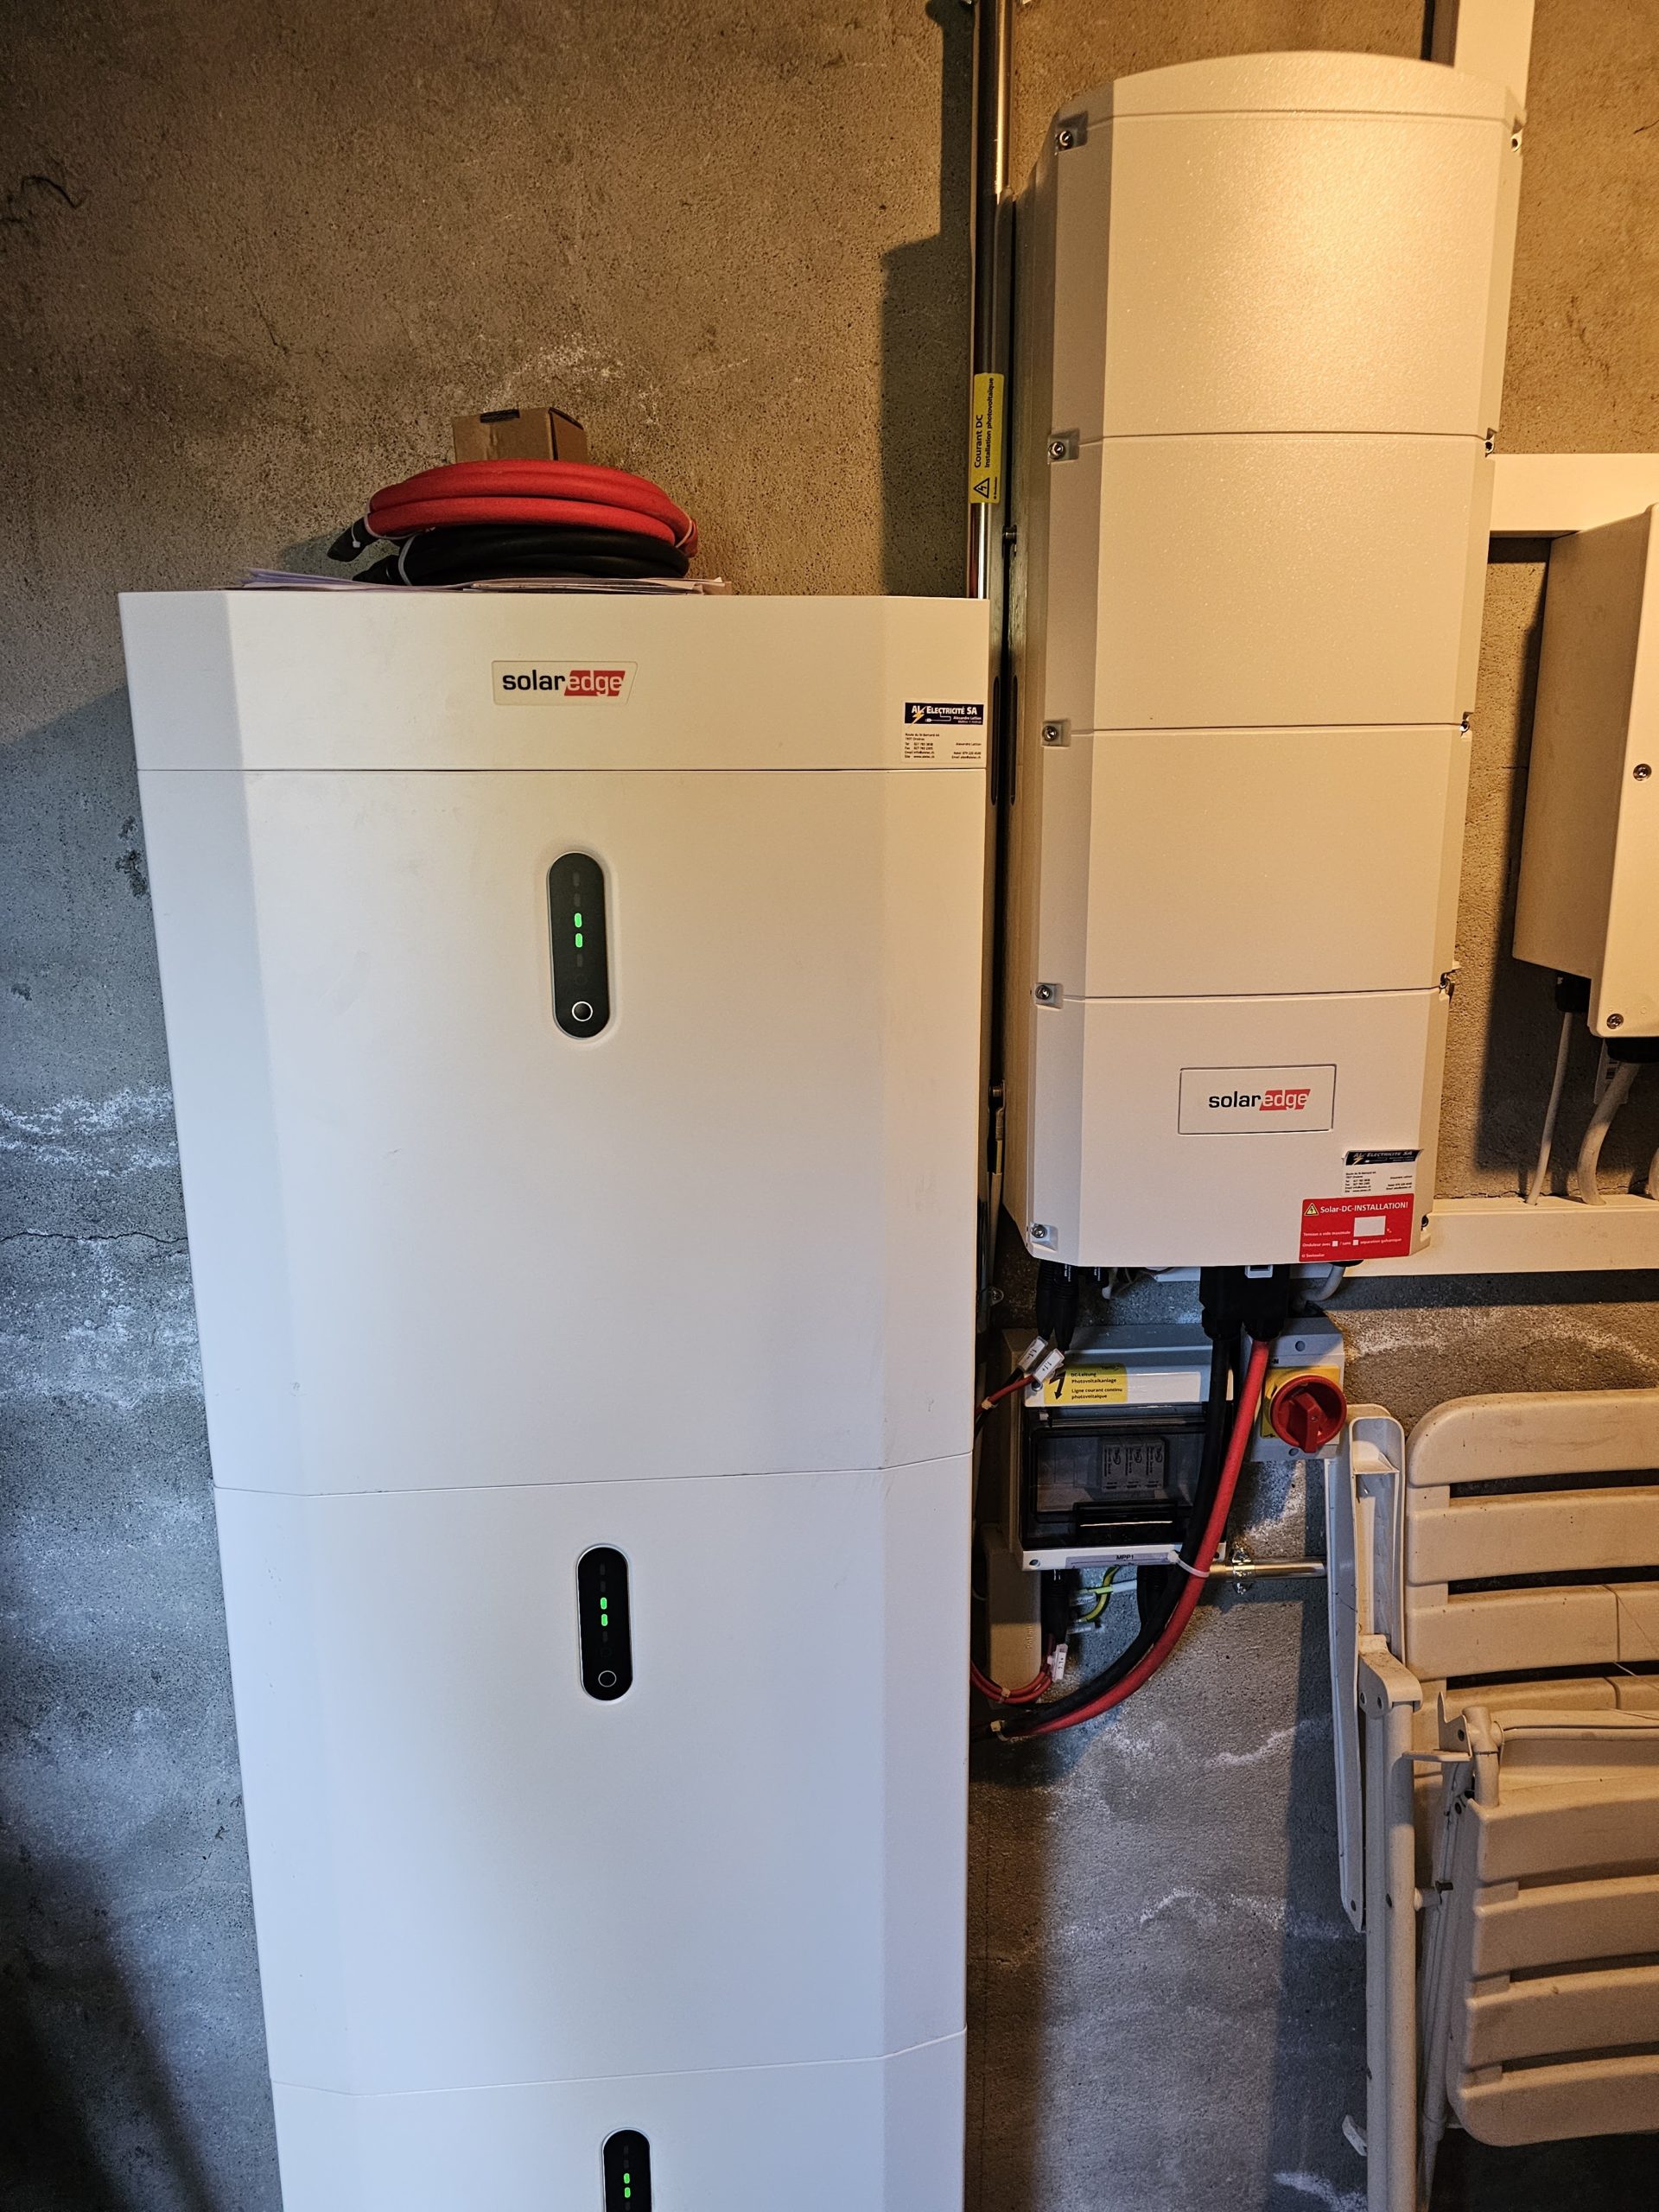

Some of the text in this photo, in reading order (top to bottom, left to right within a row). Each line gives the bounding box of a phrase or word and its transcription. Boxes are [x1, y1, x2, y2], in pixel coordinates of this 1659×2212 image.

[976, 415, 983, 429] DC
[502, 670, 623, 696] solaredge
[1208, 1089, 1308, 1110] solaredge
[1319, 1201, 1408, 1213] Solar-DC-INSTALLATION!
